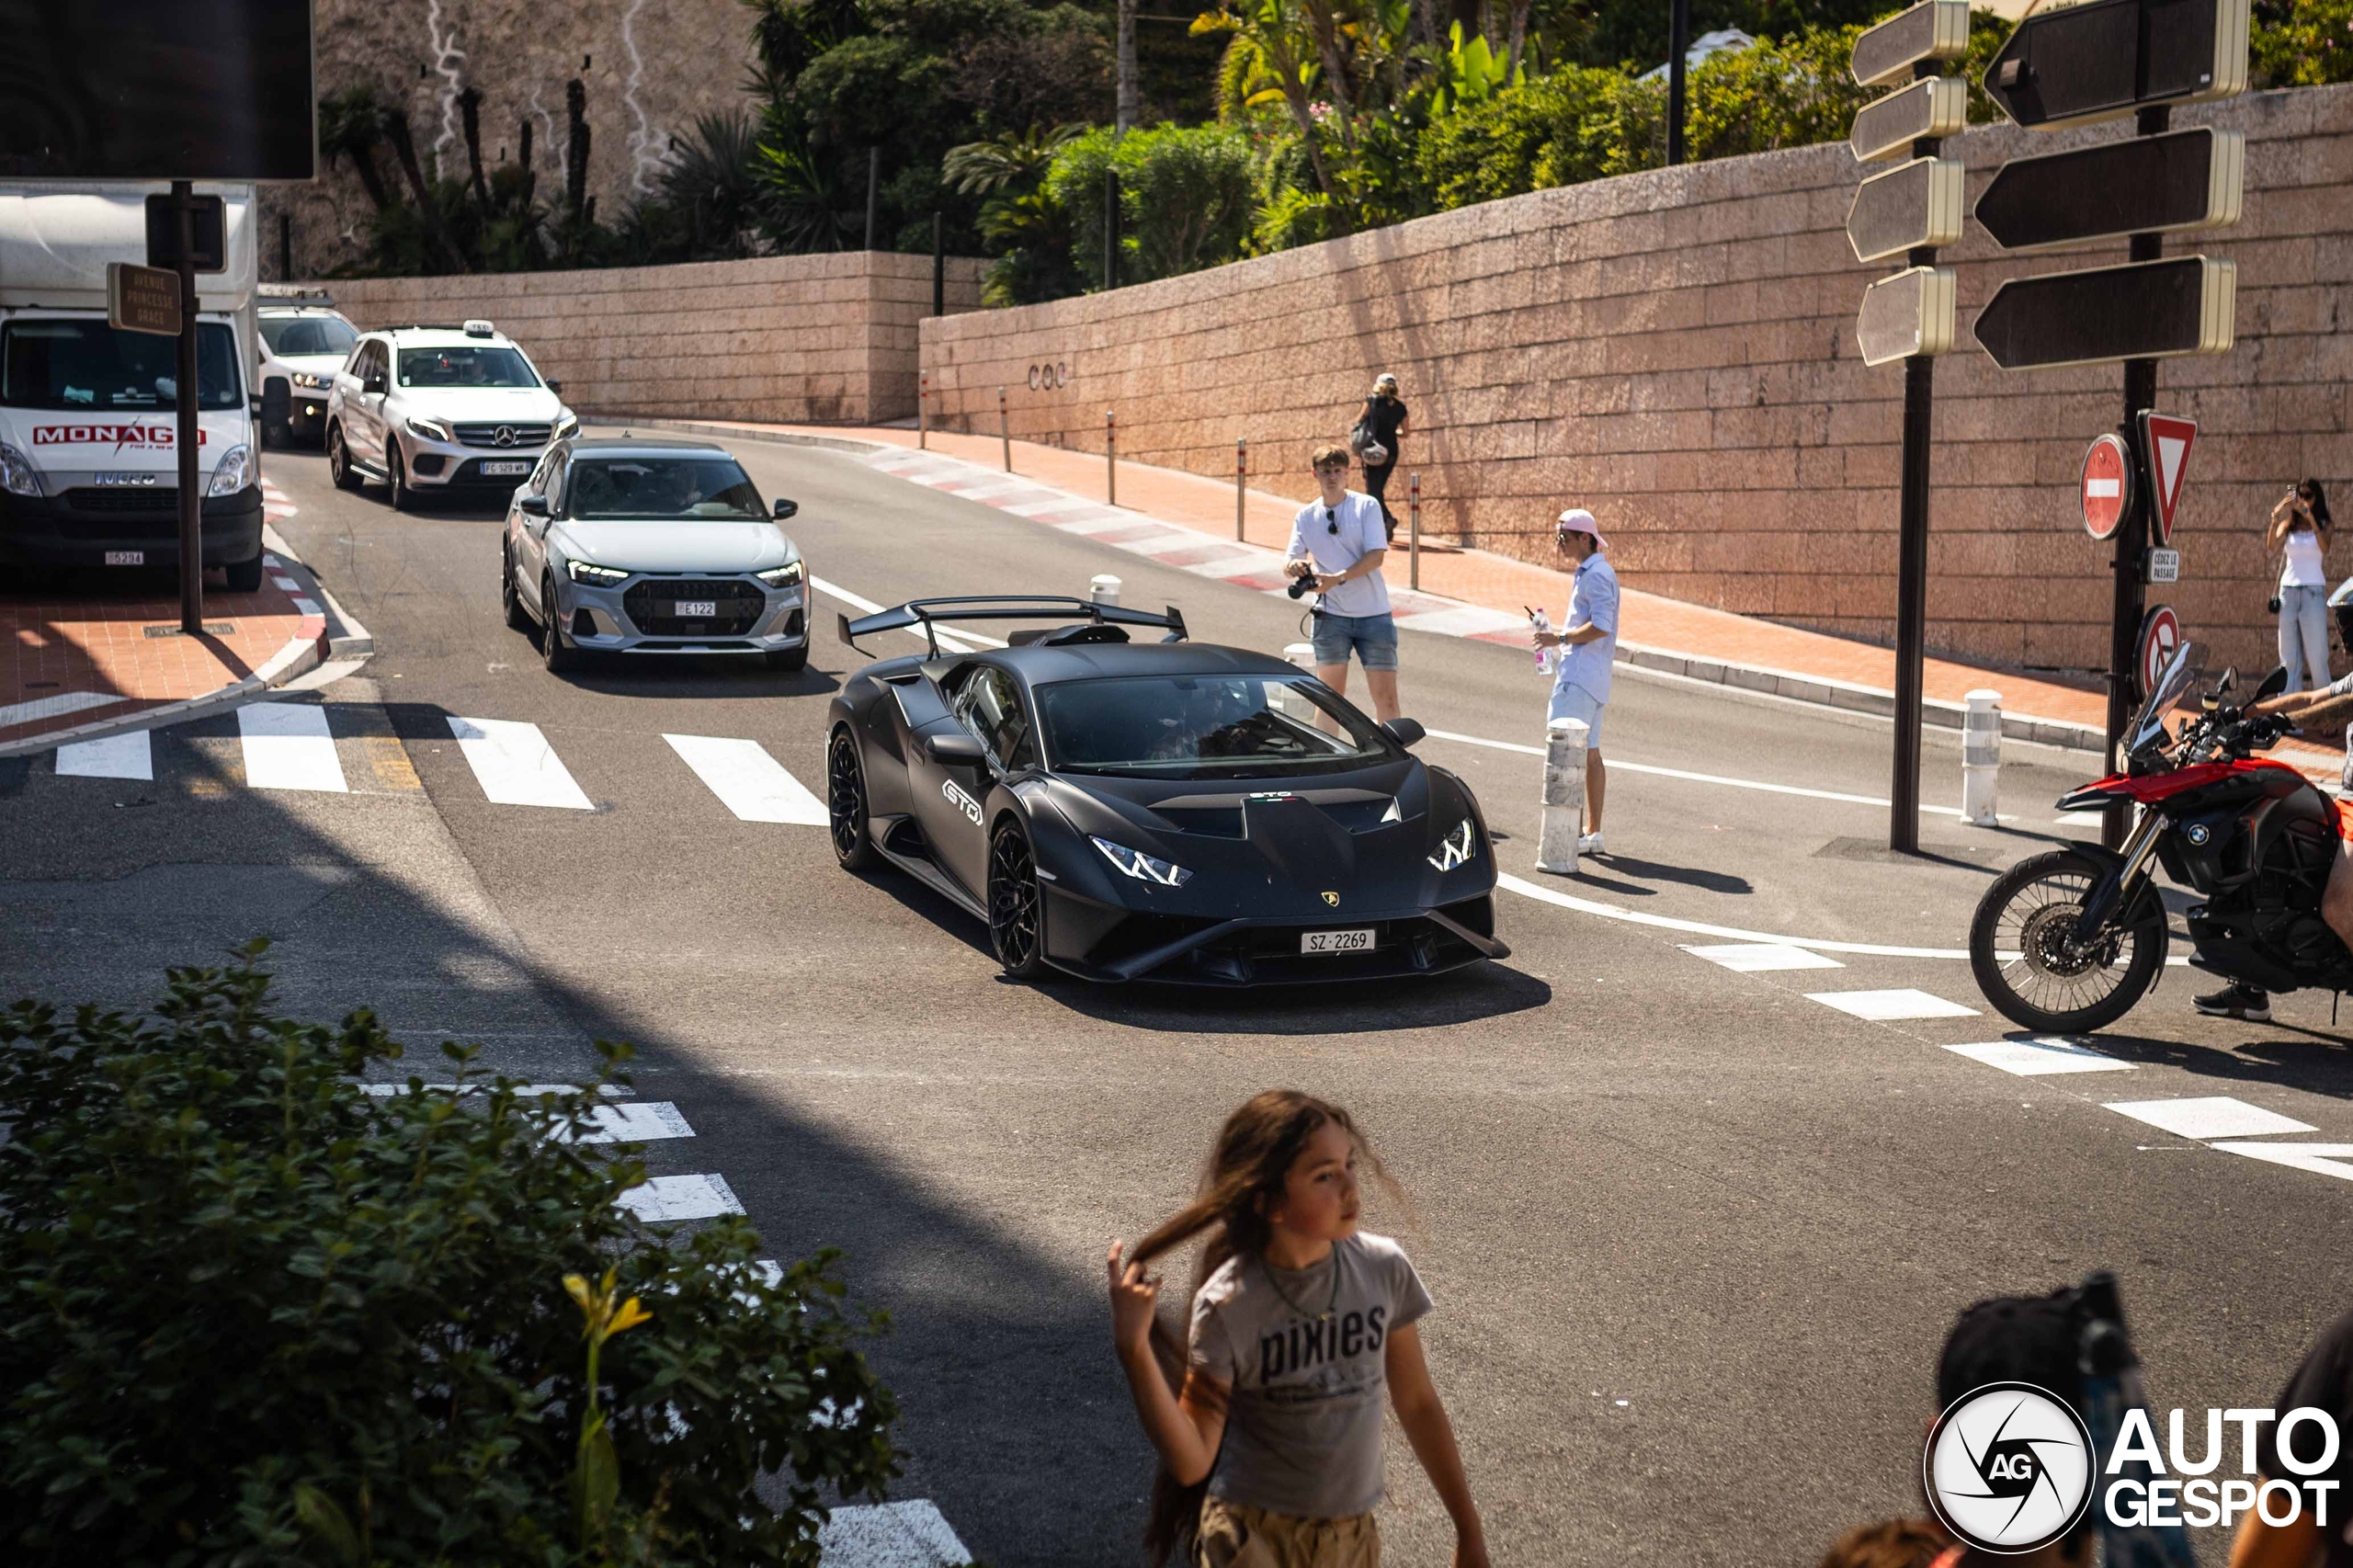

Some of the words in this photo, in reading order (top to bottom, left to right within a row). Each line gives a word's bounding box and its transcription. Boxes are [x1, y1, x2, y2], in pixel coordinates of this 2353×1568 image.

[133, 273, 165, 291] AVENUE
[127, 290, 174, 311] PRINCESSE
[137, 309, 165, 325] GRACE
[95, 472, 155, 486] IVECO
[2170, 553, 2177, 565] LE
[2154, 567, 2175, 579] PASSAGE
[685, 604, 713, 615] E122
[946, 783, 980, 823] STO
[1260, 1305, 1385, 1385] pixies
